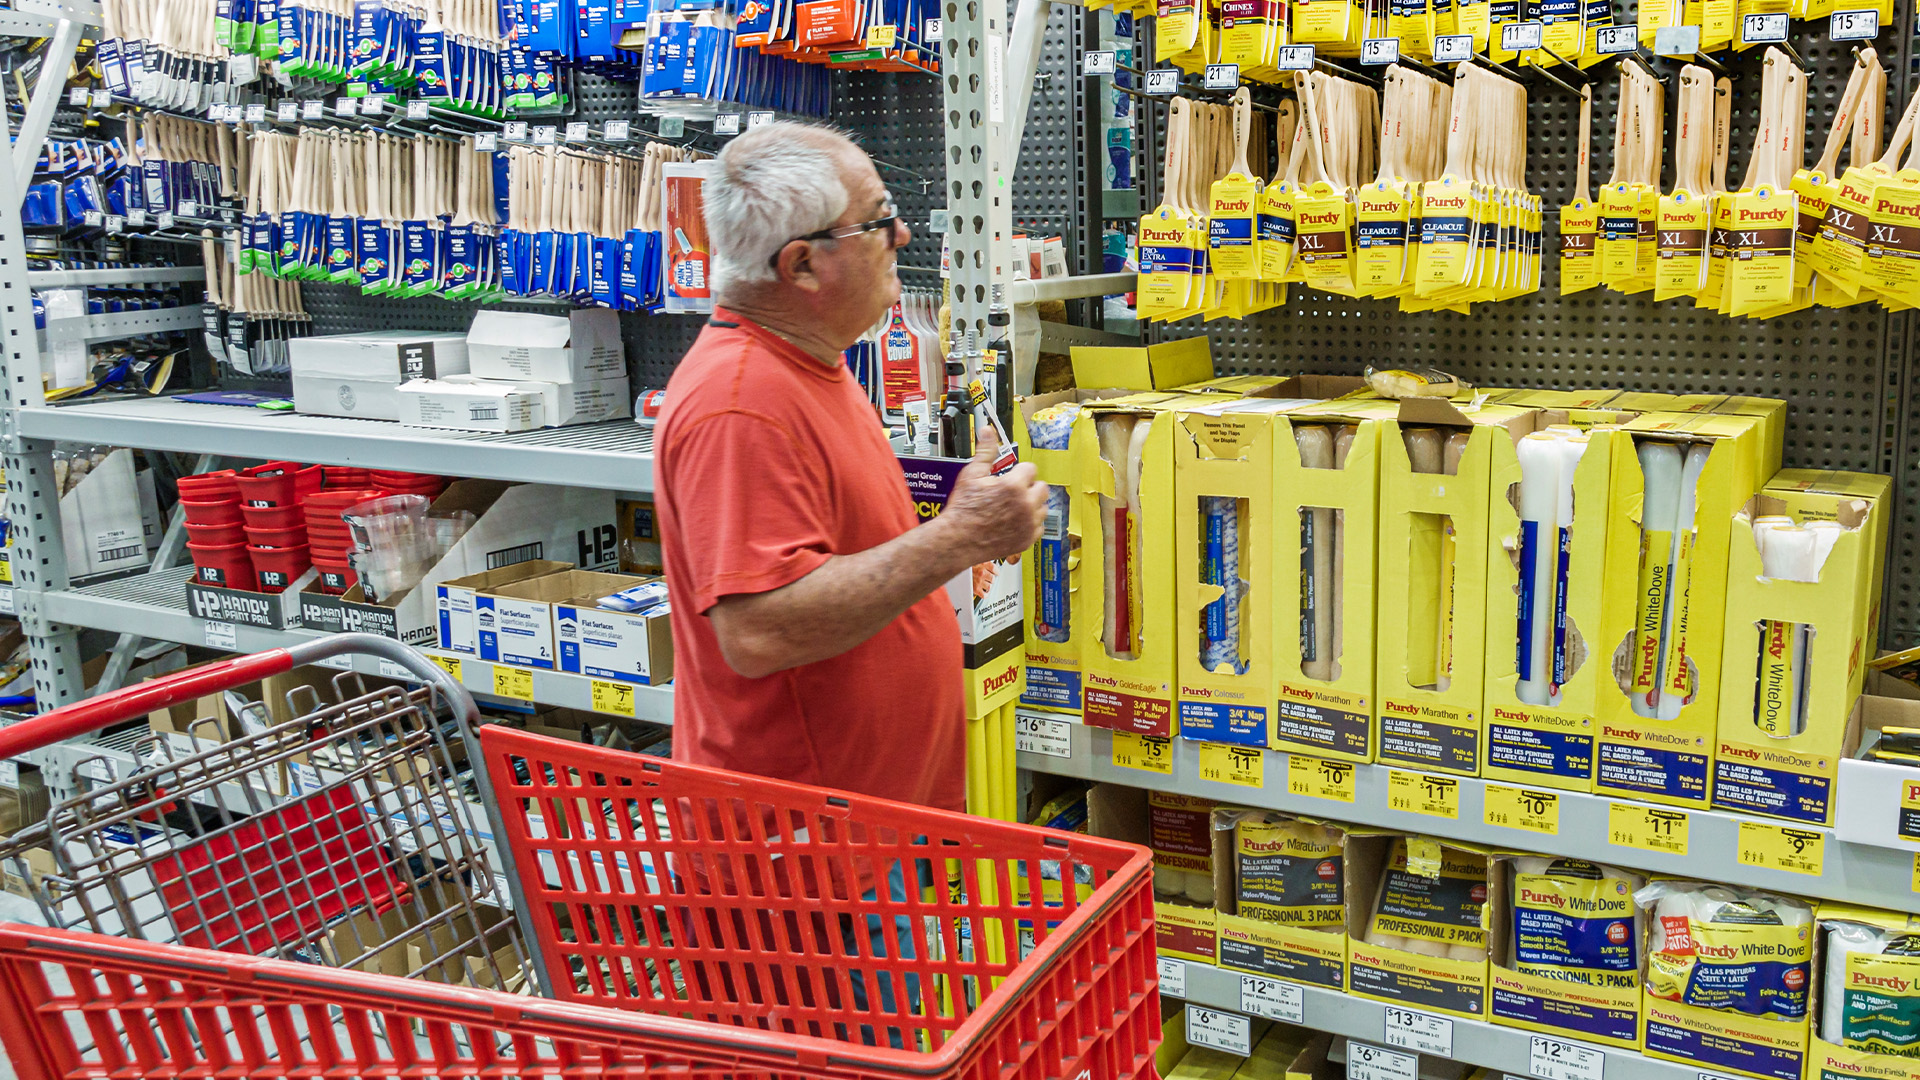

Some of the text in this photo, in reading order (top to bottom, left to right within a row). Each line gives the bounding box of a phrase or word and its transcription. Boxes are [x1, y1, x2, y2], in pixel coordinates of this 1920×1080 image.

[1223, 2, 1254, 12] CHINEX
[1541, 2, 1577, 12] CLEARCUT
[1425, 196, 1467, 209] Purdy
[1840, 184, 1870, 205] Pur
[1214, 199, 1250, 213] Purdy
[1267, 198, 1293, 212] Purdy
[1362, 201, 1400, 213] Purdy
[1608, 204, 1634, 212] Purdy
[1300, 211, 1340, 225] Purdy
[1662, 212, 1697, 223] Purdy
[1738, 208, 1788, 222] Purdy
[1828, 208, 1856, 231] XL
[1210, 227, 1230, 235] EXTRA
[1564, 219, 1594, 228] Purdy
[1142, 228, 1185, 243] Purdy
[1302, 234, 1325, 250] XL
[1564, 234, 1586, 248] XL
[1662, 231, 1688, 246] XL
[1738, 232, 1765, 246] XL
[1870, 224, 1902, 244] XL
[1142, 252, 1166, 261] EXTRA
[685, 260, 693, 287] ROLLER
[692, 260, 706, 288] COVER
[890, 330, 906, 338] PAINT
[888, 339, 910, 348] BRUSH
[888, 347, 912, 361] COVER
[920, 472, 942, 481] Grade
[918, 480, 937, 490] Poles
[578, 524, 617, 568] HP
[602, 552, 618, 562] CO.
[193, 590, 220, 618] HP
[222, 594, 270, 616] HANDY
[1644, 564, 1665, 632] WhiteDove
[225, 609, 272, 626] PAINT PAIL
[362, 611, 393, 624] HANDY
[500, 608, 532, 620] Flat Surfaces
[978, 604, 993, 616] Attach
[341, 606, 362, 631] HP
[500, 618, 540, 630] Superficies planas
[582, 619, 614, 631] Flat Surfaces
[400, 625, 438, 642] HANDY
[582, 628, 623, 641] Superficies planas
[1637, 634, 1658, 688] Purdy
[983, 666, 1019, 696] Purdy
[1088, 673, 1158, 694] Purdy GoldenEagle
[1182, 686, 1246, 700] Purdy Colossus
[1282, 685, 1351, 706] Purdy Marathon
[1766, 663, 1785, 732] WhiteDove
[1385, 700, 1459, 720] Purdy Marathon
[1494, 708, 1576, 727] Purdy WhiteDove
[1017, 716, 1039, 732] $16
[1602, 726, 1690, 746] Purdy WhiteDove
[1139, 740, 1162, 756] $15
[1720, 744, 1812, 768] Purdy WhiteDove
[1228, 754, 1250, 770] $11
[1318, 767, 1343, 784] $10
[1812, 778, 1826, 787] Nap
[1420, 782, 1444, 800] $11
[1517, 797, 1546, 815] $10
[1811, 806, 1824, 814] mm
[1644, 816, 1671, 835] $11
[1243, 838, 1330, 852] Purdy Marathon
[1788, 838, 1806, 854] $9
[1520, 889, 1597, 912] Purdy White
[1241, 906, 1342, 922] PROFESSIONAL 3 PACK
[1224, 928, 1250, 940] Purdy
[1377, 919, 1484, 944] PROFESSIONAL 3 PACK
[1612, 932, 1625, 940] FREE
[1741, 944, 1805, 957] White Dove
[1354, 952, 1416, 972] Purdy Marathon
[1242, 977, 1276, 995] $12 48
[1596, 974, 1634, 988] 3 PACK
[1852, 972, 1911, 992] Purdy
[1495, 976, 1634, 1008] Purdy WhiteDove PROFESSIONAL PACK
[1196, 1009, 1218, 1024] $6 48
[1387, 1008, 1424, 1027] $13 78
[1878, 1014, 1910, 1026] Surfaces
[1650, 1008, 1800, 1048] Purdy WhiteDove PROFESSIONAL PACK
[1357, 1046, 1382, 1062] $6 78
[1534, 1038, 1572, 1058] $12 98
[1826, 1056, 1884, 1075] Purdy Ultra
